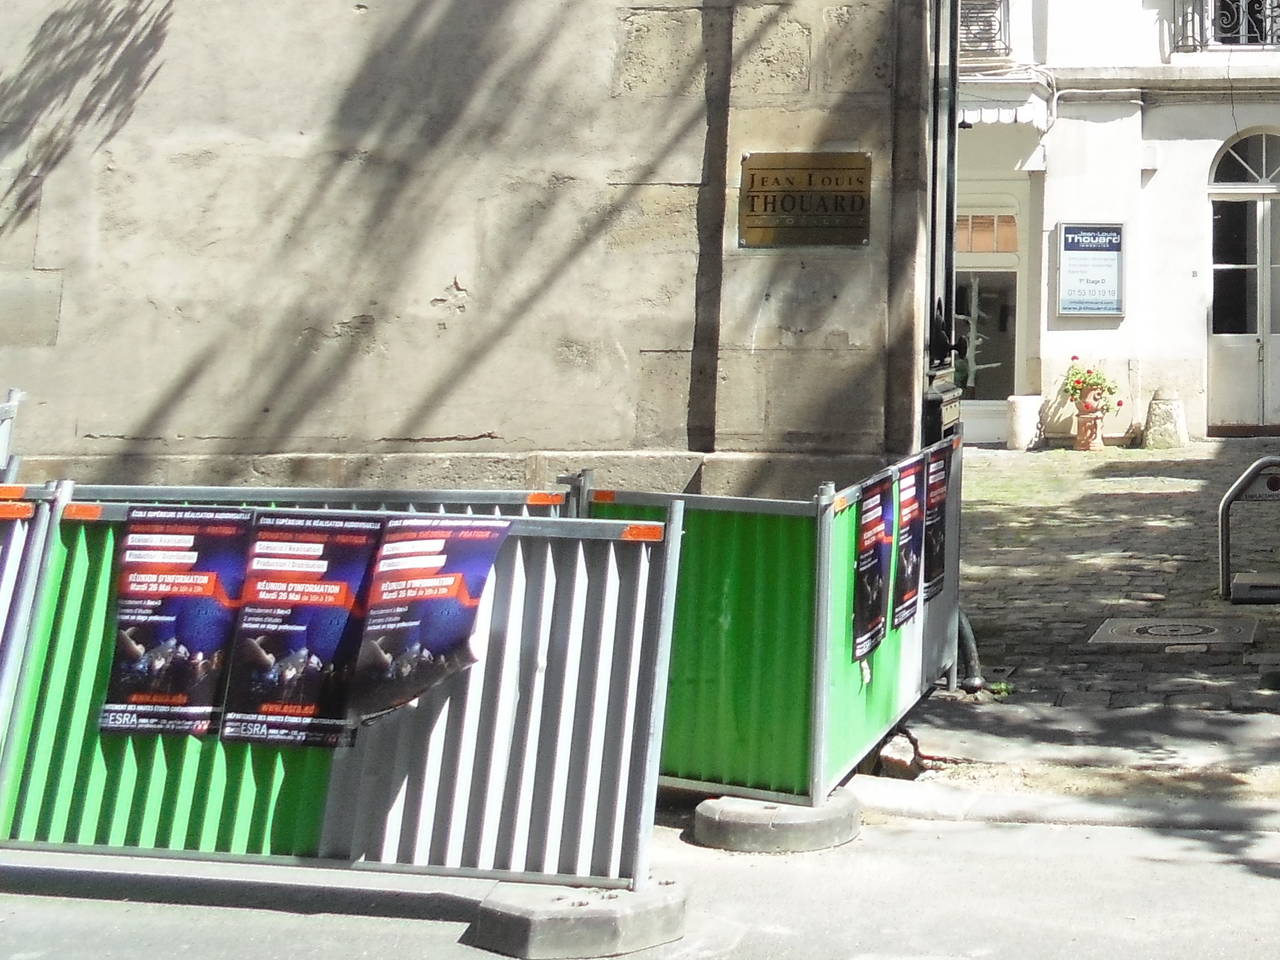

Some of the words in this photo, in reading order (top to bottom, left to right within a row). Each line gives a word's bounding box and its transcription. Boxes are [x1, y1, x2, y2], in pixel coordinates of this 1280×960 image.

[749, 173, 795, 190] JEAN
[746, 193, 866, 213] THOUARD
[1065, 234, 1121, 244] Thouard
[256, 581, 287, 591] RÉUNION
[288, 582, 340, 593] D'INFORMATION
[109, 713, 138, 725] ESRA
[241, 722, 268, 735] ESRA
